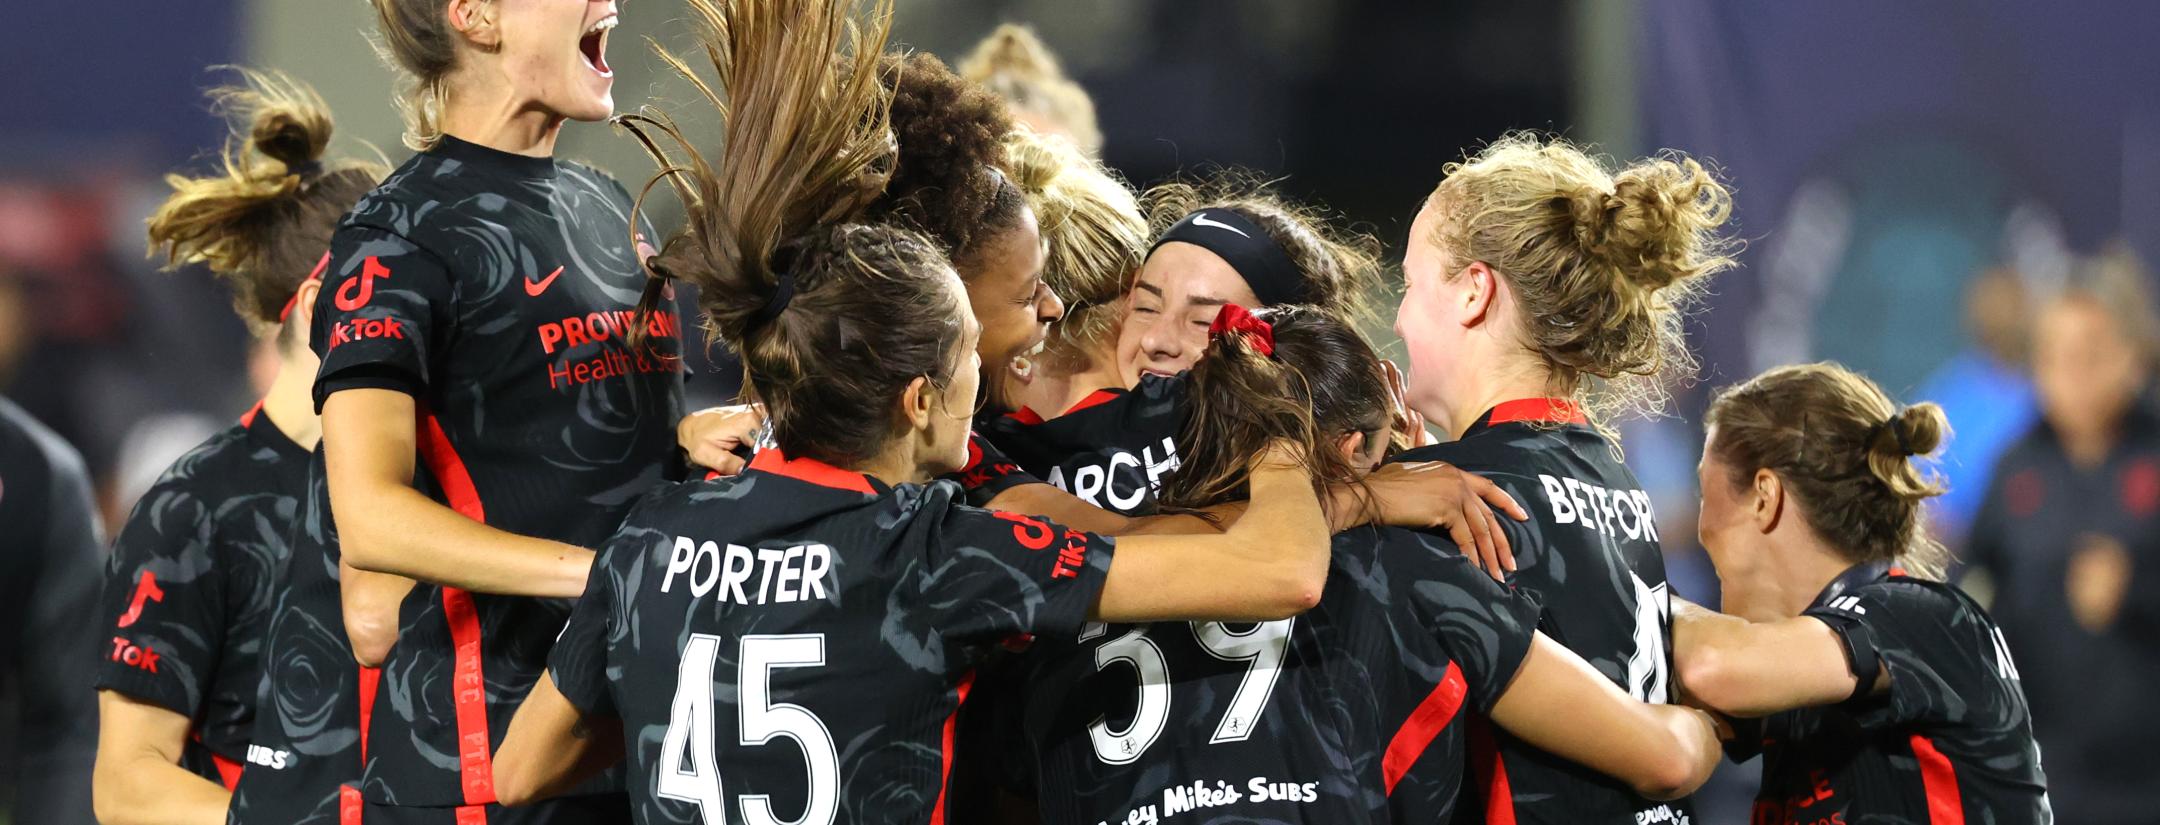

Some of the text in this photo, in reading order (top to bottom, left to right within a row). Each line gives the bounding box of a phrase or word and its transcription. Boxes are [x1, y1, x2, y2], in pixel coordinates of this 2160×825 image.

[1538, 474, 1659, 542] BETFOR
[660, 535, 832, 606] PORTER
[657, 632, 841, 825] 45
[1163, 779, 1243, 818] Mike's
